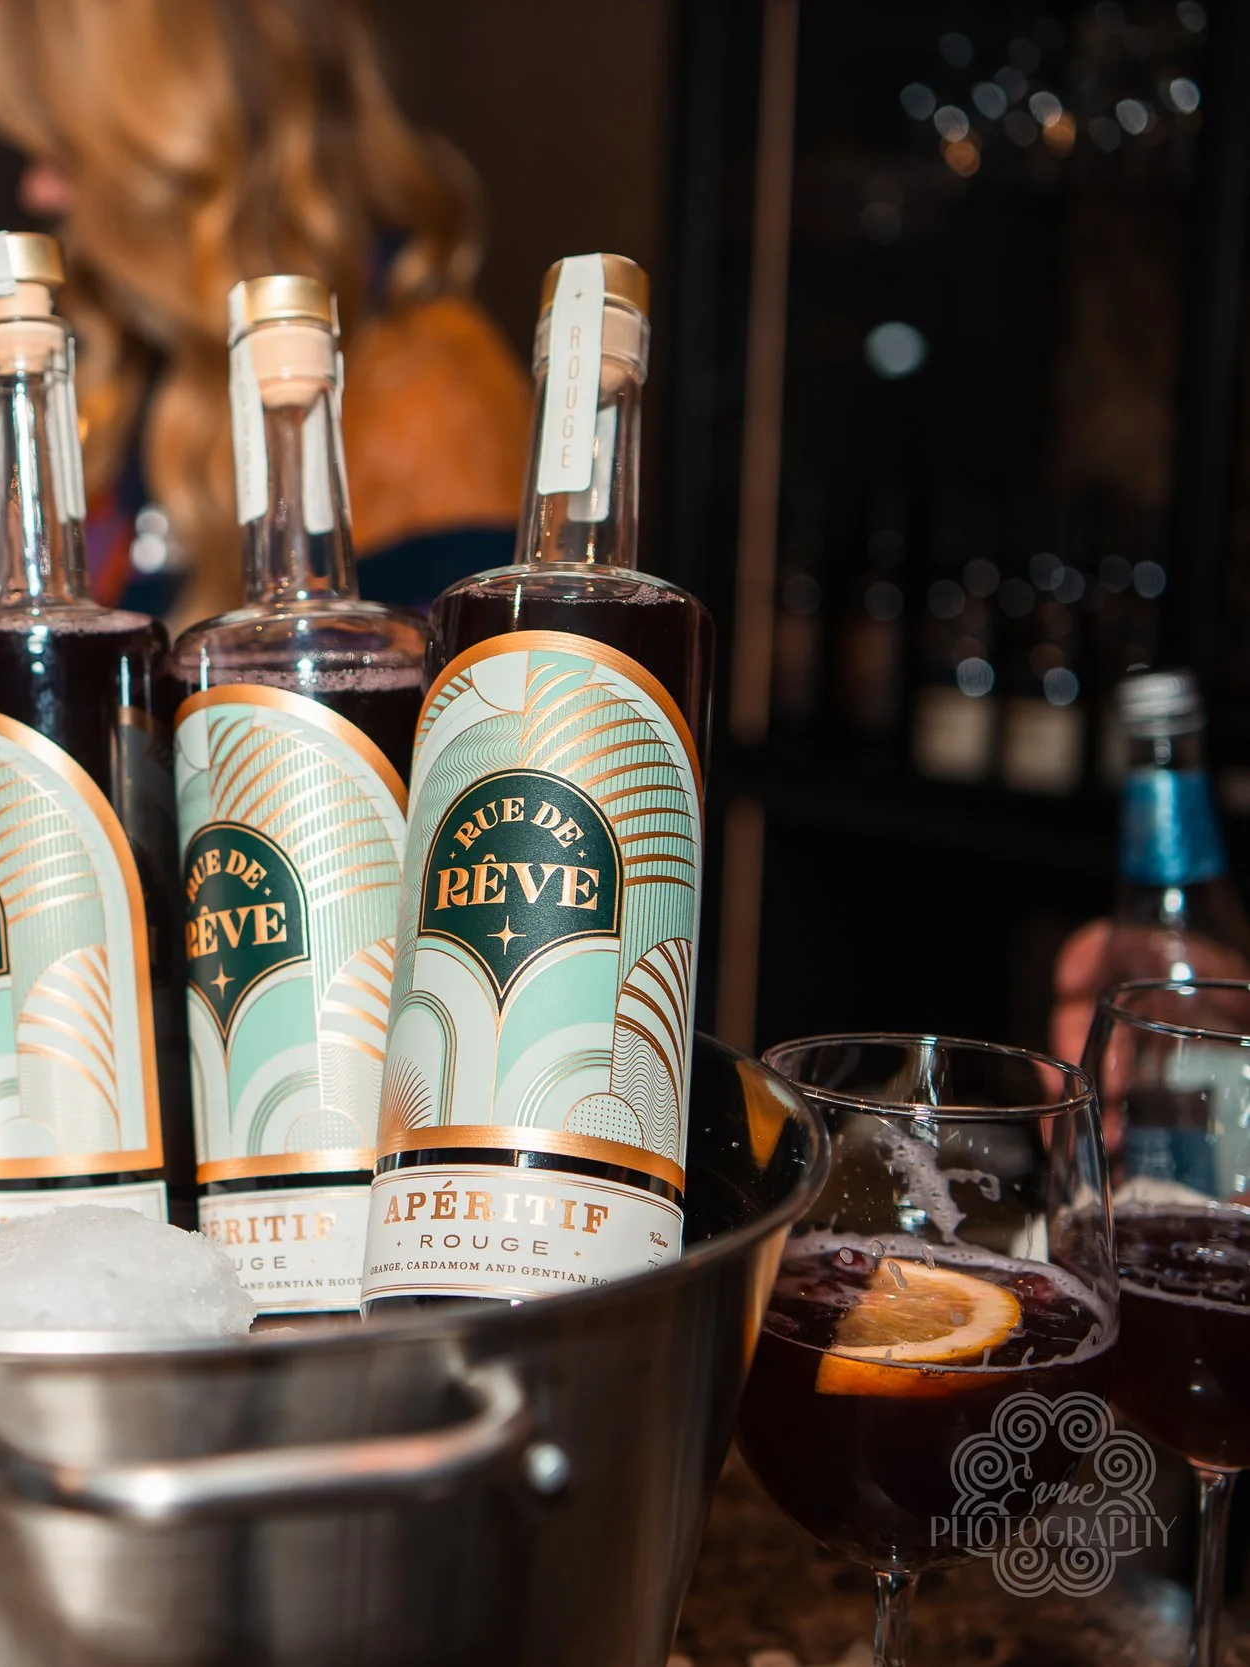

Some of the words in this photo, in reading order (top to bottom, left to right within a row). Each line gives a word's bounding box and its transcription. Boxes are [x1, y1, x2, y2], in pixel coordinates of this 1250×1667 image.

[560, 325, 582, 469] ROUGE
[453, 797, 525, 851] RUE
[530, 800, 585, 848] DE
[186, 849, 221, 904] RUE
[225, 849, 267, 890] DE
[434, 854, 600, 911] RÊVE
[383, 1180, 610, 1235] APÉRITIF
[232, 1256, 287, 1272] UGE
[370, 1261, 404, 1276] ORANGE,
[406, 1260, 480, 1272] CARDAMOM
[485, 1263, 517, 1274] AND
[521, 1266, 587, 1284] GENTIAN
[420, 1234, 549, 1256] ROUGE
[267, 1278, 324, 1290] GENTIAN
